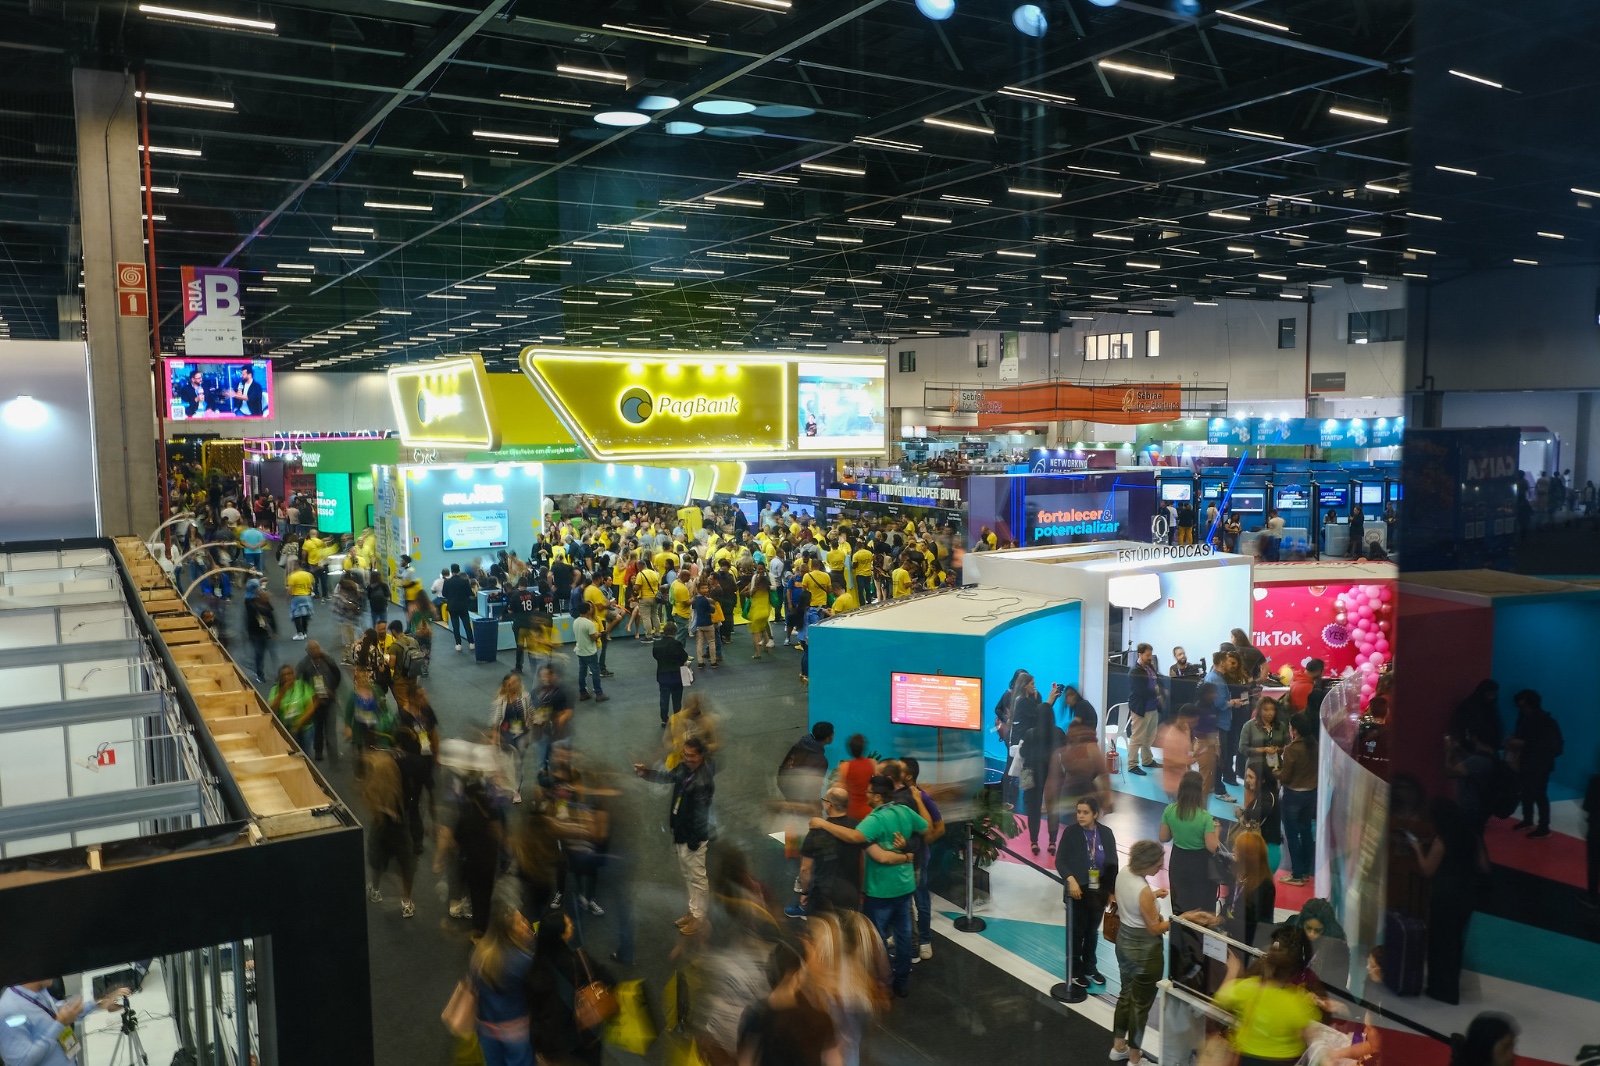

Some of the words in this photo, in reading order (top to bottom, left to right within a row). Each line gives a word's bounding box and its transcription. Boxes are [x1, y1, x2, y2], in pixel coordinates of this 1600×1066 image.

[188, 279, 203, 312] RUA
[204, 274, 240, 316] B
[962, 392, 984, 401] Sebrae
[1137, 391, 1162, 400] Sebrae
[659, 396, 739, 418] PagBank
[879, 484, 917, 498] INNOVATION
[917, 487, 940, 499] SUPER
[940, 488, 962, 501] BOWL
[1038, 509, 1103, 523] fortalecer
[1103, 510, 1112, 521] &
[1035, 521, 1120, 540] potencializar
[1120, 546, 1161, 563] ESTÚDIO
[1163, 544, 1215, 559] PODCAST
[522, 600, 533, 611] 18
[545, 602, 554, 614] 18
[1328, 630, 1345, 641] YES
